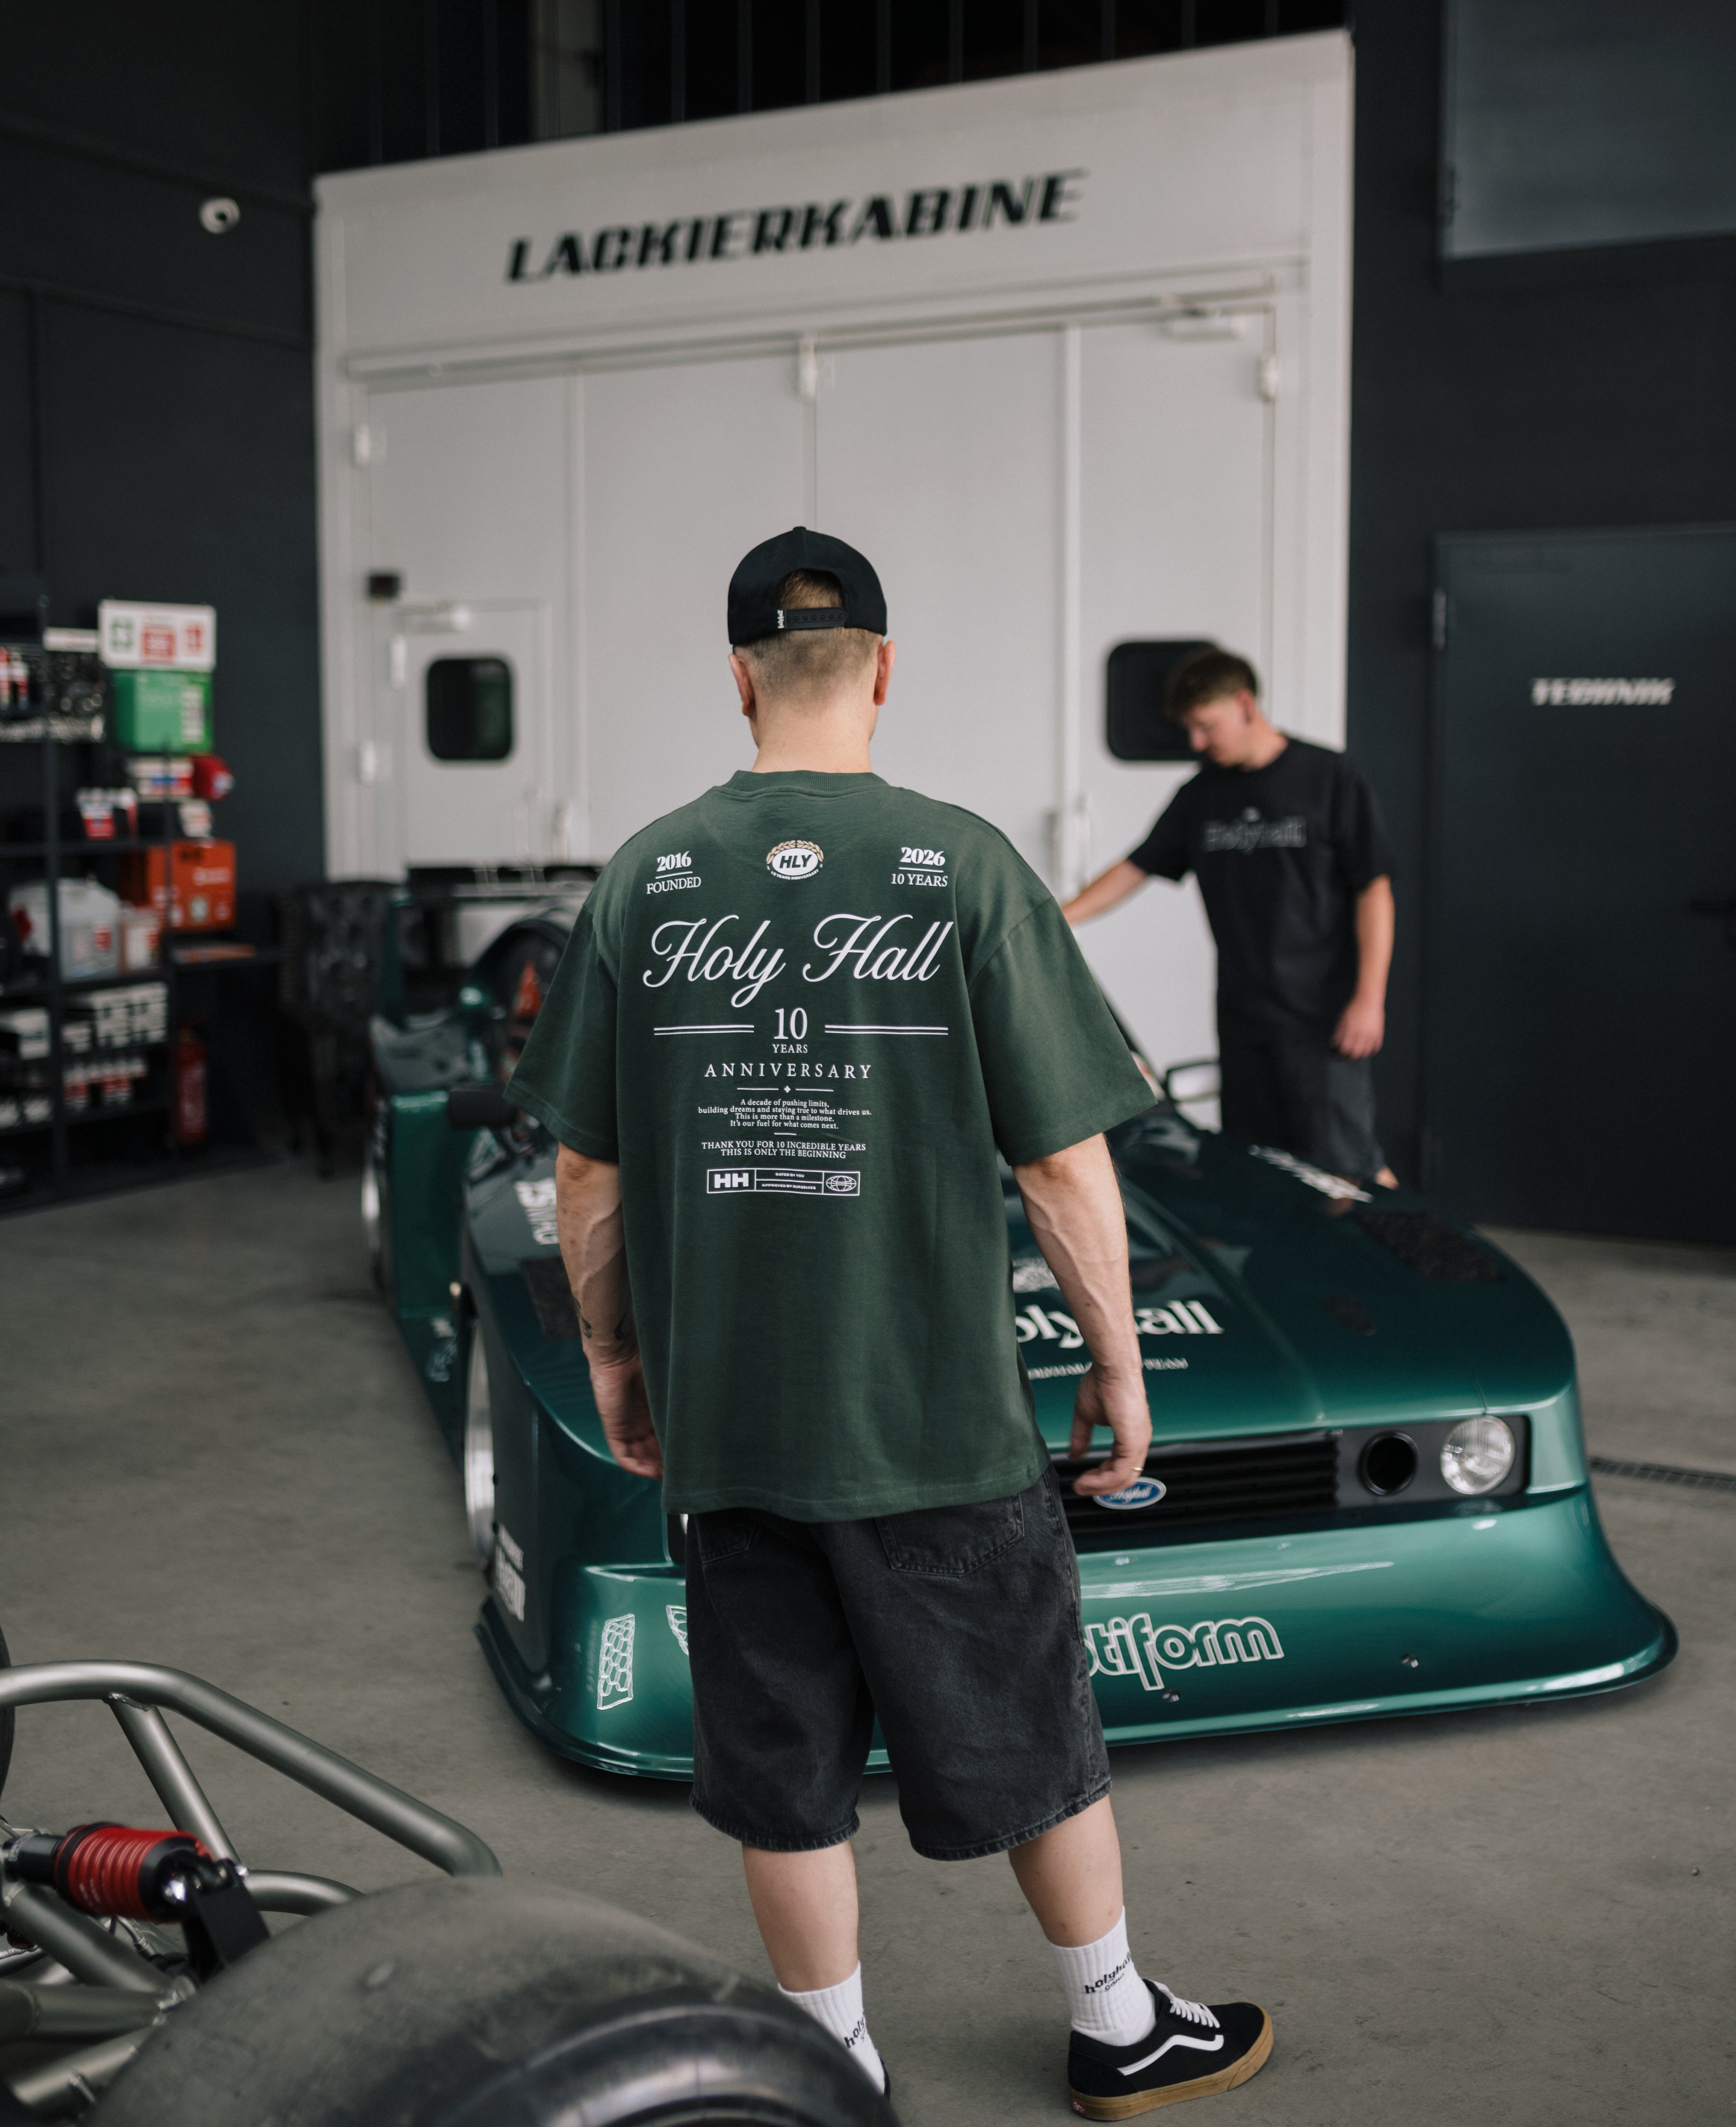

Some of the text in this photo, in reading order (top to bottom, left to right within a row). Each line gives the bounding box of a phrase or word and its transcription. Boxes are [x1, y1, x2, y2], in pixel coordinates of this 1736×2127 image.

[504, 167, 1089, 285] LACKIERKABINE
[656, 850, 692, 872] 2016
[779, 854, 812, 869] HLY
[900, 847, 946, 866] 2026
[791, 869, 819, 880] ANNIVERSARY
[891, 873, 948, 887] 10 YEARS
[646, 874, 702, 894] FOUNDED
[643, 913, 954, 1008] Holy Hall
[774, 1007, 808, 1040] 10
[772, 1044, 808, 1053] YEARS
[704, 1063, 872, 1079] ANNIVERSARY
[698, 1106, 728, 1115] building
[772, 1106, 796, 1115] staying
[819, 1106, 836, 1115] what
[782, 1099, 807, 1108] pushing
[801, 1114, 834, 1122] milestone.
[702, 1141, 734, 1149] THANK
[787, 1141, 836, 1150] INCREDIBLE
[798, 1149, 847, 1159] BEGINNING
[714, 1173, 749, 1189] HH
[1016, 1300, 1225, 1348] olyall
[844, 2012, 865, 2049] holy
